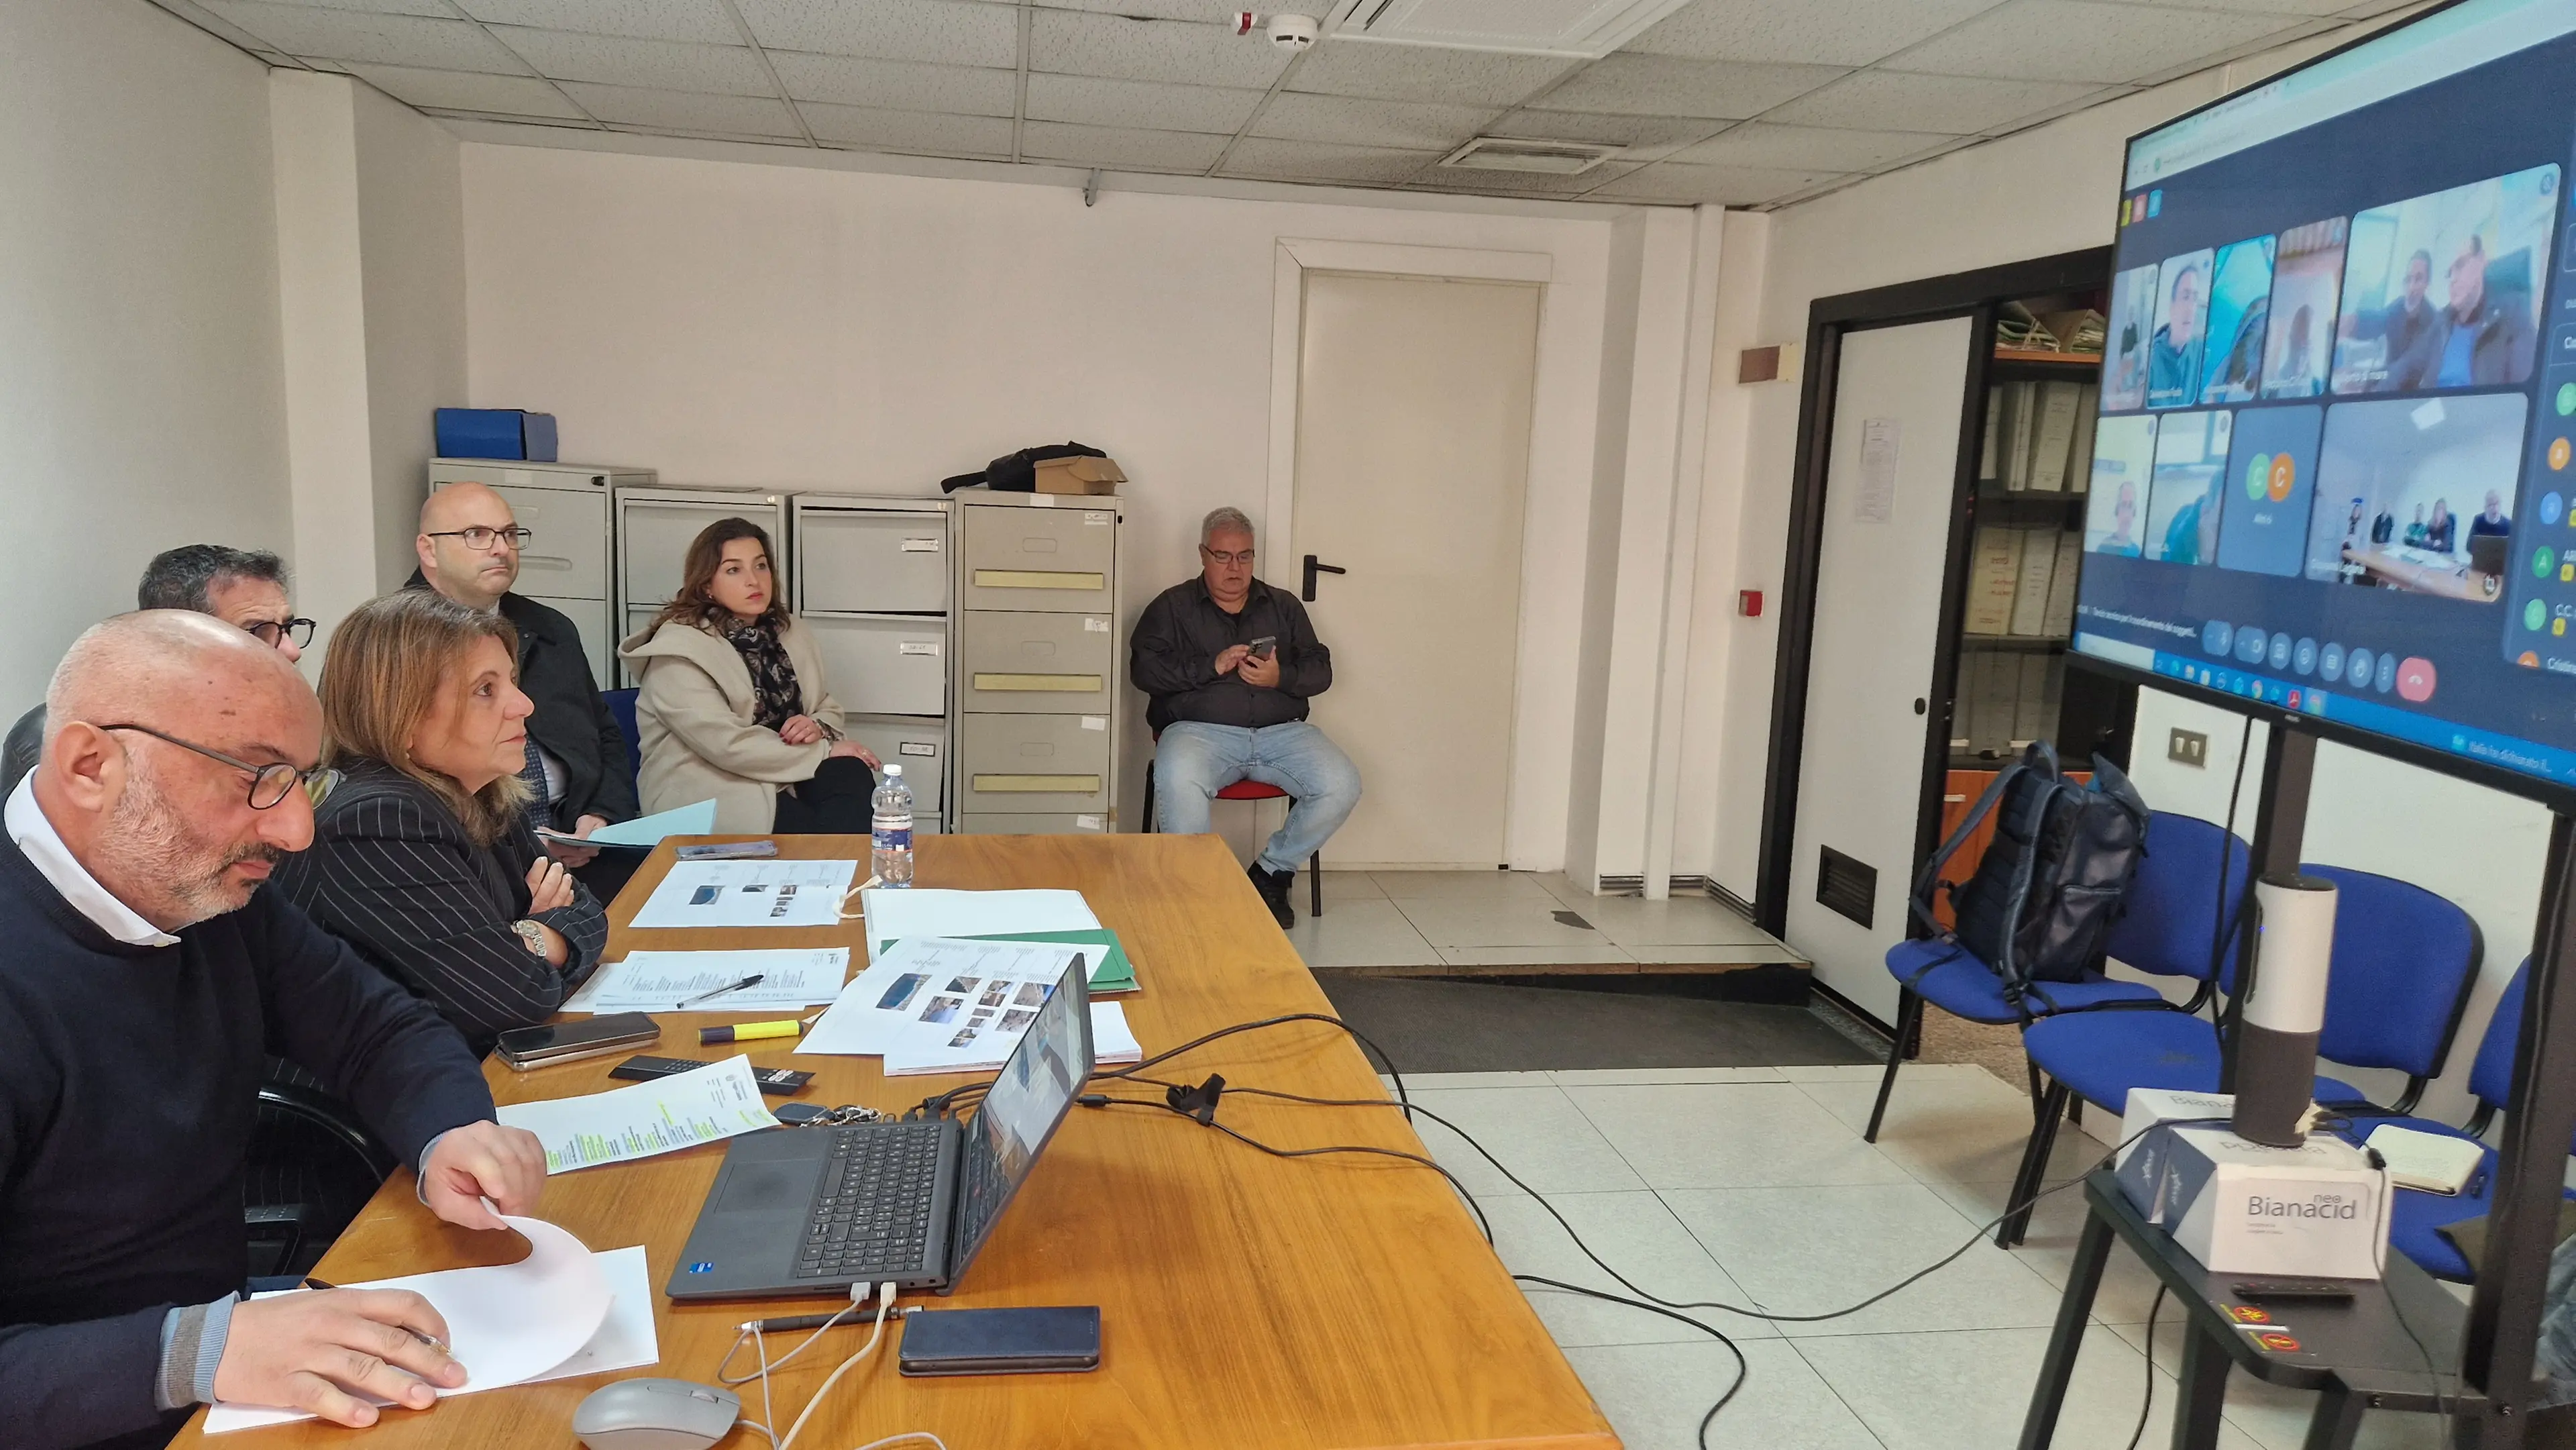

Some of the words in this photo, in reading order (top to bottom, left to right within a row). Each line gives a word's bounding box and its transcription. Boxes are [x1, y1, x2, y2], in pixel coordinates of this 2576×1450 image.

[2275, 466, 2286, 488] C
[2247, 1196, 2357, 1220] Bianacid
[2314, 1194, 2342, 1204] neo
